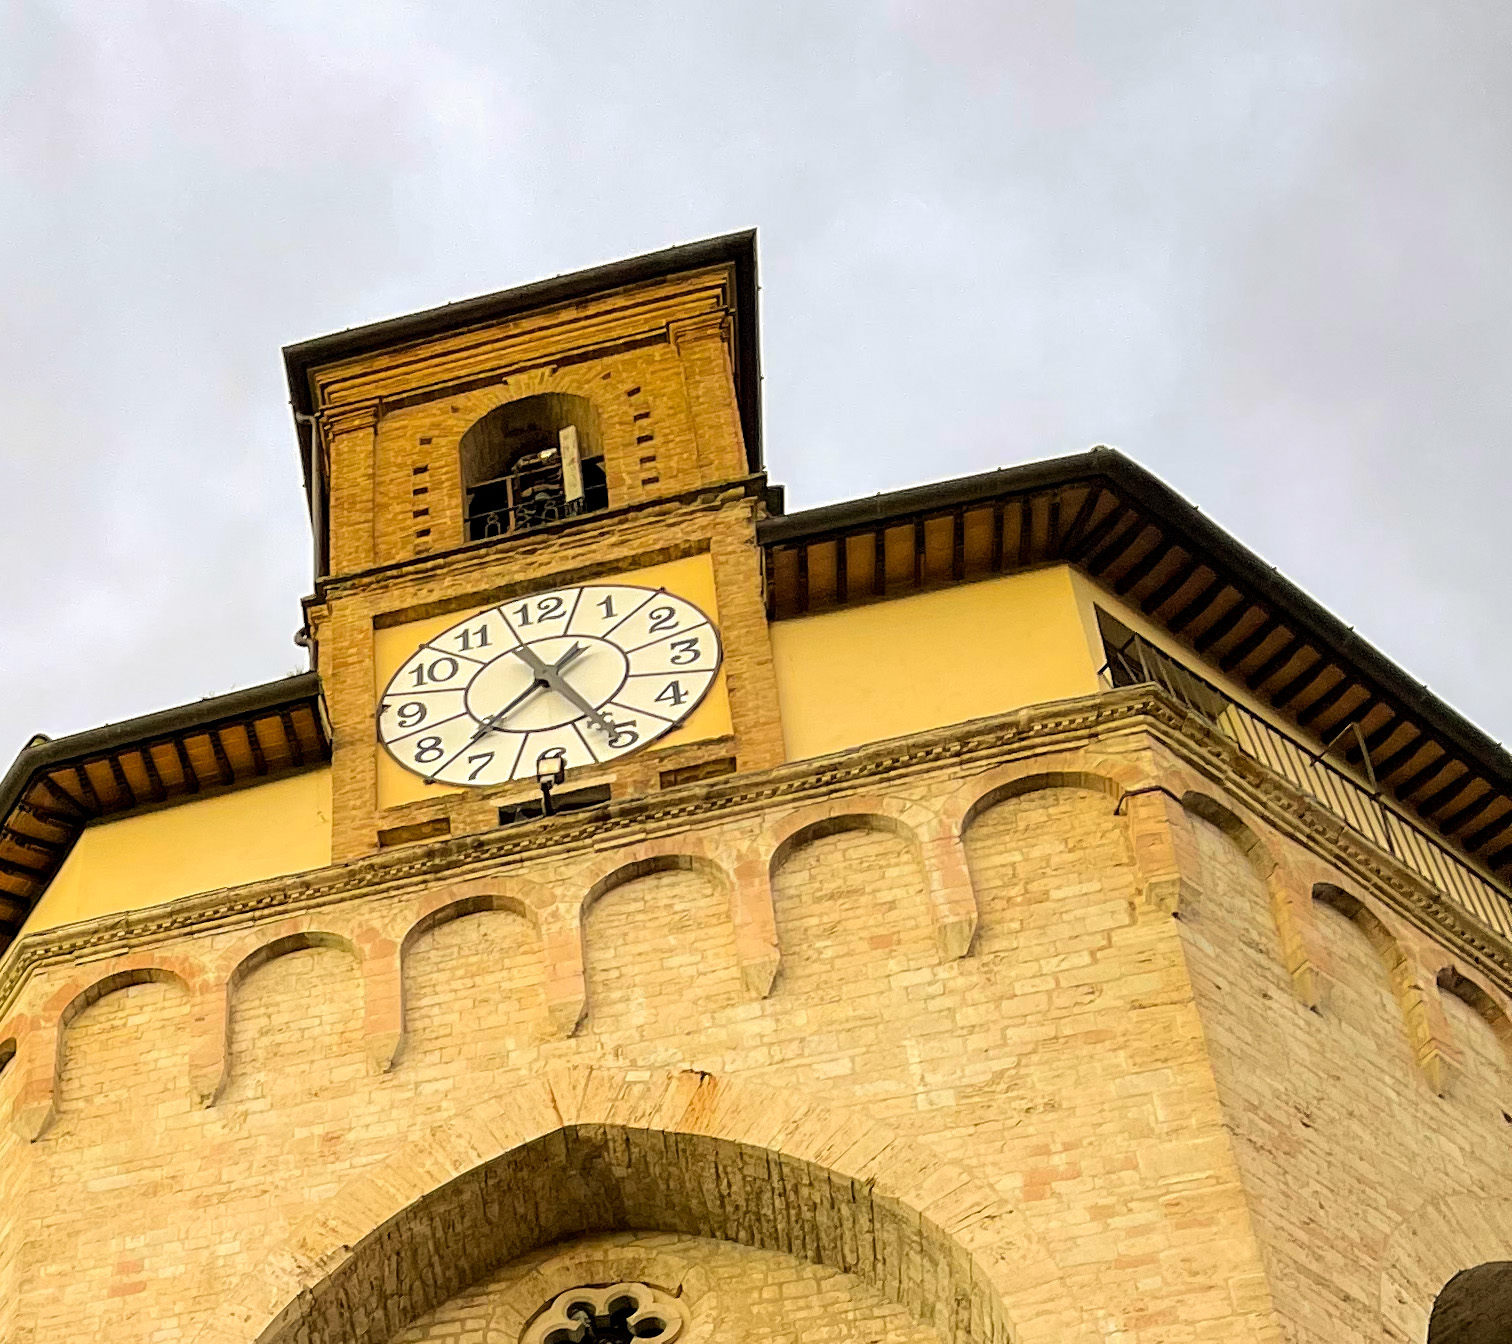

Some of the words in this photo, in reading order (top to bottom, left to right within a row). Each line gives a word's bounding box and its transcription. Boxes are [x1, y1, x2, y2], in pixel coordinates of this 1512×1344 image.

[512, 596, 568, 628] 12
[597, 595, 618, 620] 1
[648, 606, 679, 633] 2
[454, 624, 493, 652] 11
[669, 637, 701, 665] 3
[409, 657, 459, 687] 10
[654, 680, 688, 707] 4
[397, 702, 427, 727] 9
[414, 736, 445, 763] 8
[467, 751, 495, 781] 7
